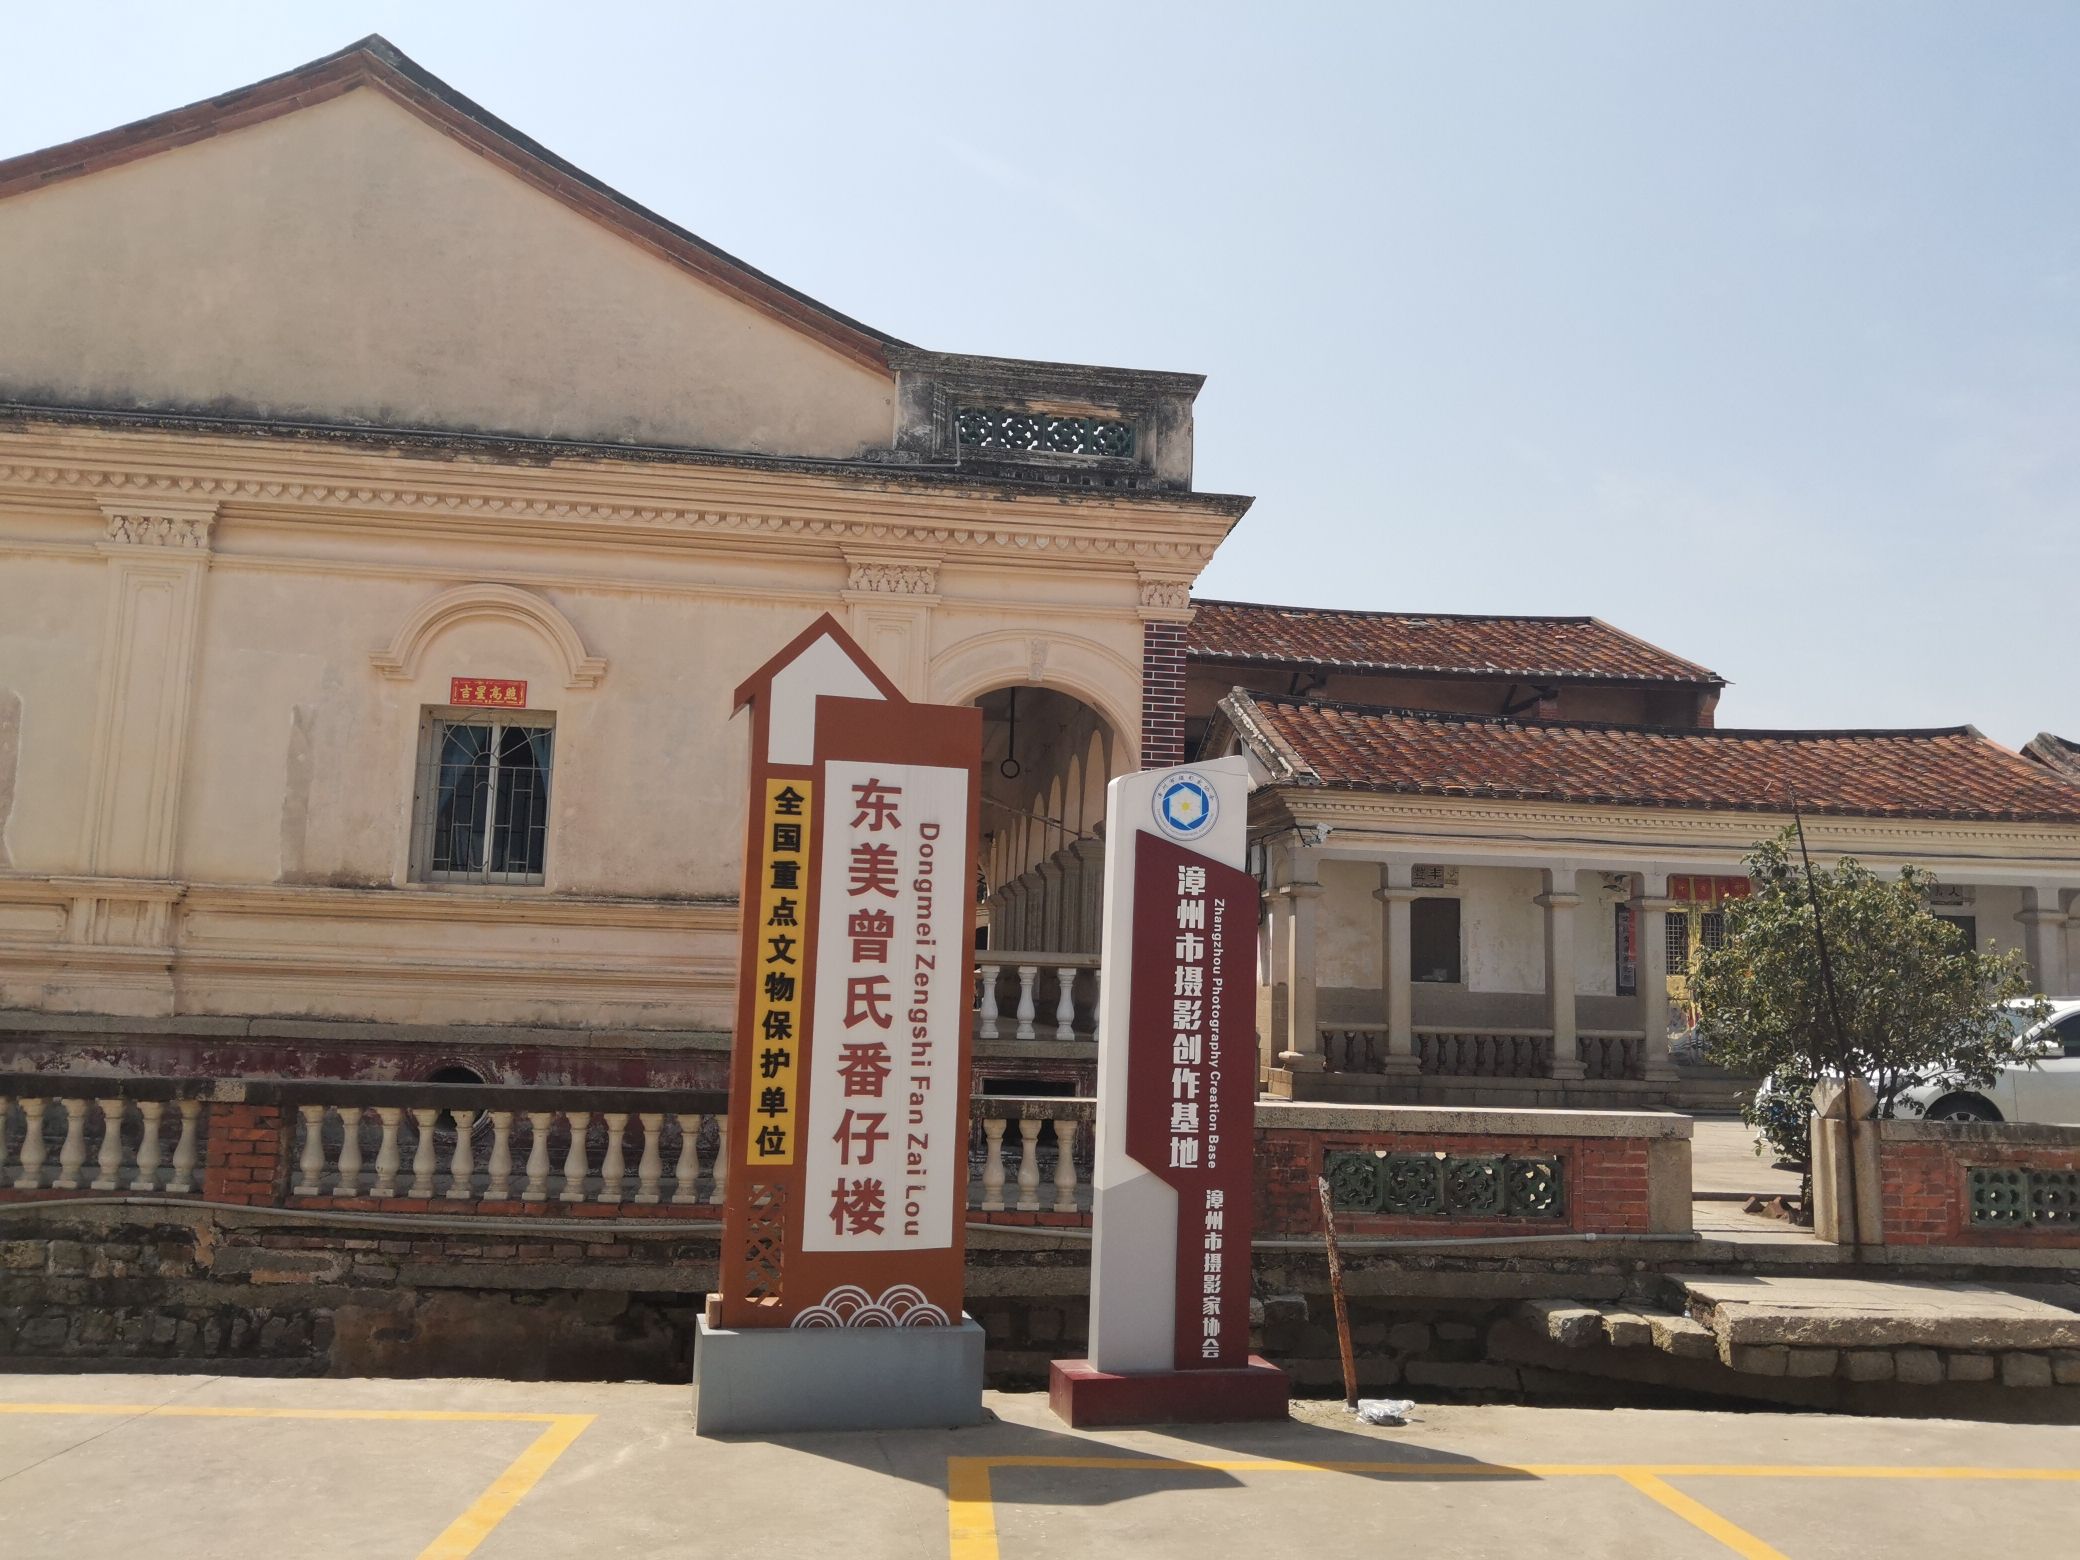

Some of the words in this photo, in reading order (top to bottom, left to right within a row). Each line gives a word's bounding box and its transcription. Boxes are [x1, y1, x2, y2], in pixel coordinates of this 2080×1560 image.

[459, 684, 517, 701] 吉星高照
[913, 823, 940, 945] Dongmei
[755, 785, 805, 1157] 全国重点文物保护单位
[1211, 898, 1225, 974] Zhangzhou
[829, 777, 902, 1236] 东美曾氏番仔楼
[908, 954, 935, 1067] Zengshi
[1169, 865, 1206, 1168] 漳州市摄影创作基地
[1208, 978, 1223, 1068] Photography
[908, 1076, 930, 1124] Fan
[1208, 1071, 1221, 1131] Creation
[906, 1133, 928, 1175] Zai
[1207, 1135, 1219, 1169] Base
[904, 1185, 926, 1236] Lou
[1202, 1189, 1224, 1358] 漳州市摄影家协会
